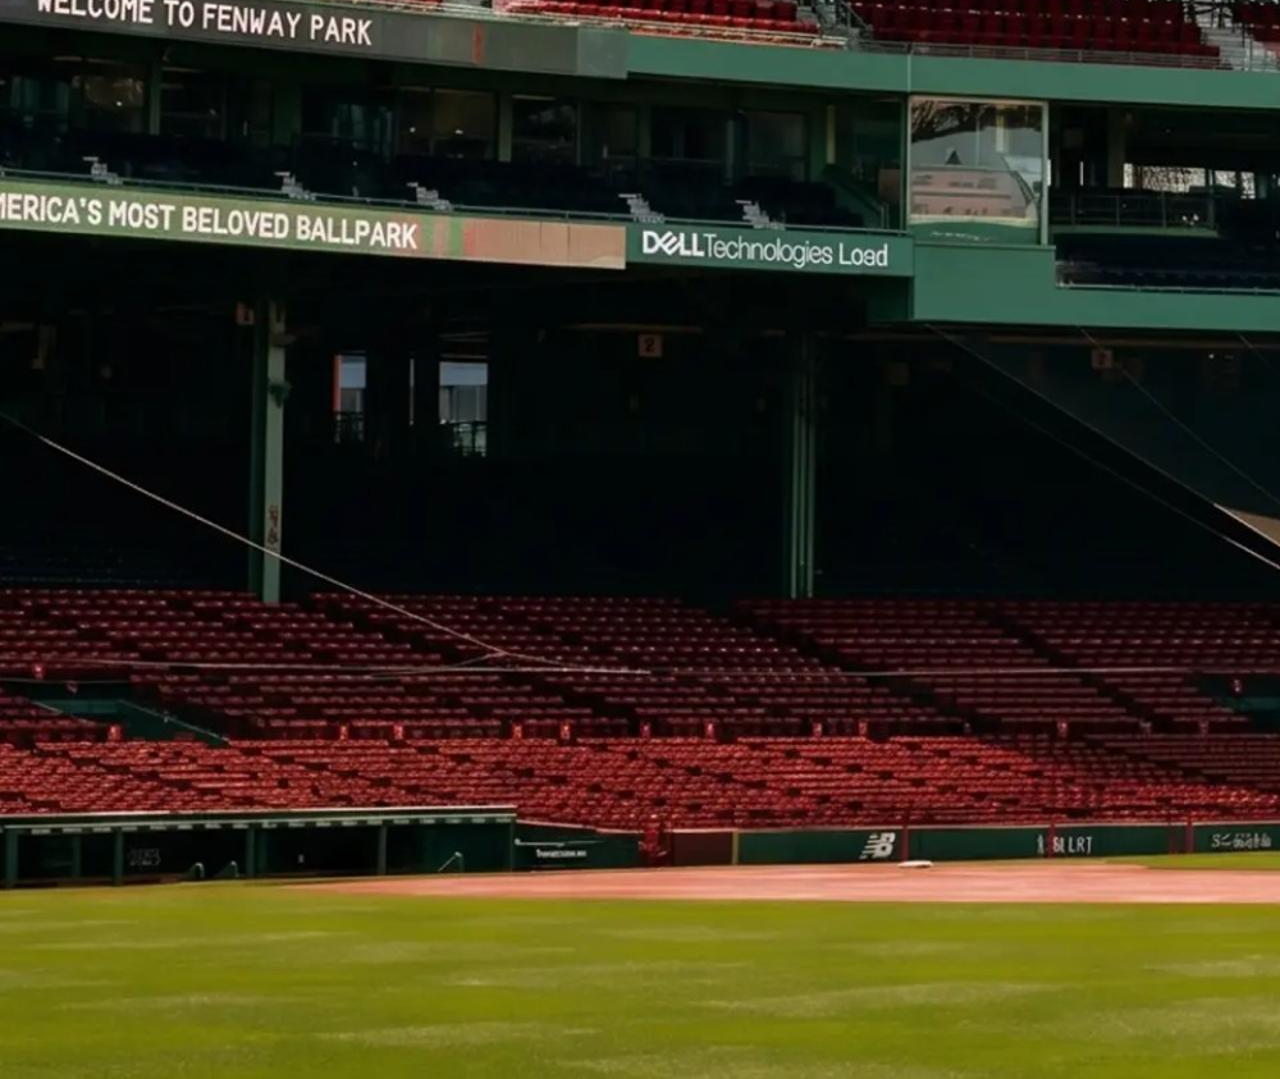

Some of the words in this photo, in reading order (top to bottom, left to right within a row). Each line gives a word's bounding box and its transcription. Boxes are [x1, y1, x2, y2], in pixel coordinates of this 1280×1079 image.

[202, 3, 301, 39] FENWAY
[309, 14, 373, 46] PARK
[108, 200, 176, 231] MOST
[182, 207, 290, 239] BELOVED
[296, 214, 418, 250] BALLPARK
[703, 233, 833, 268] Technologies
